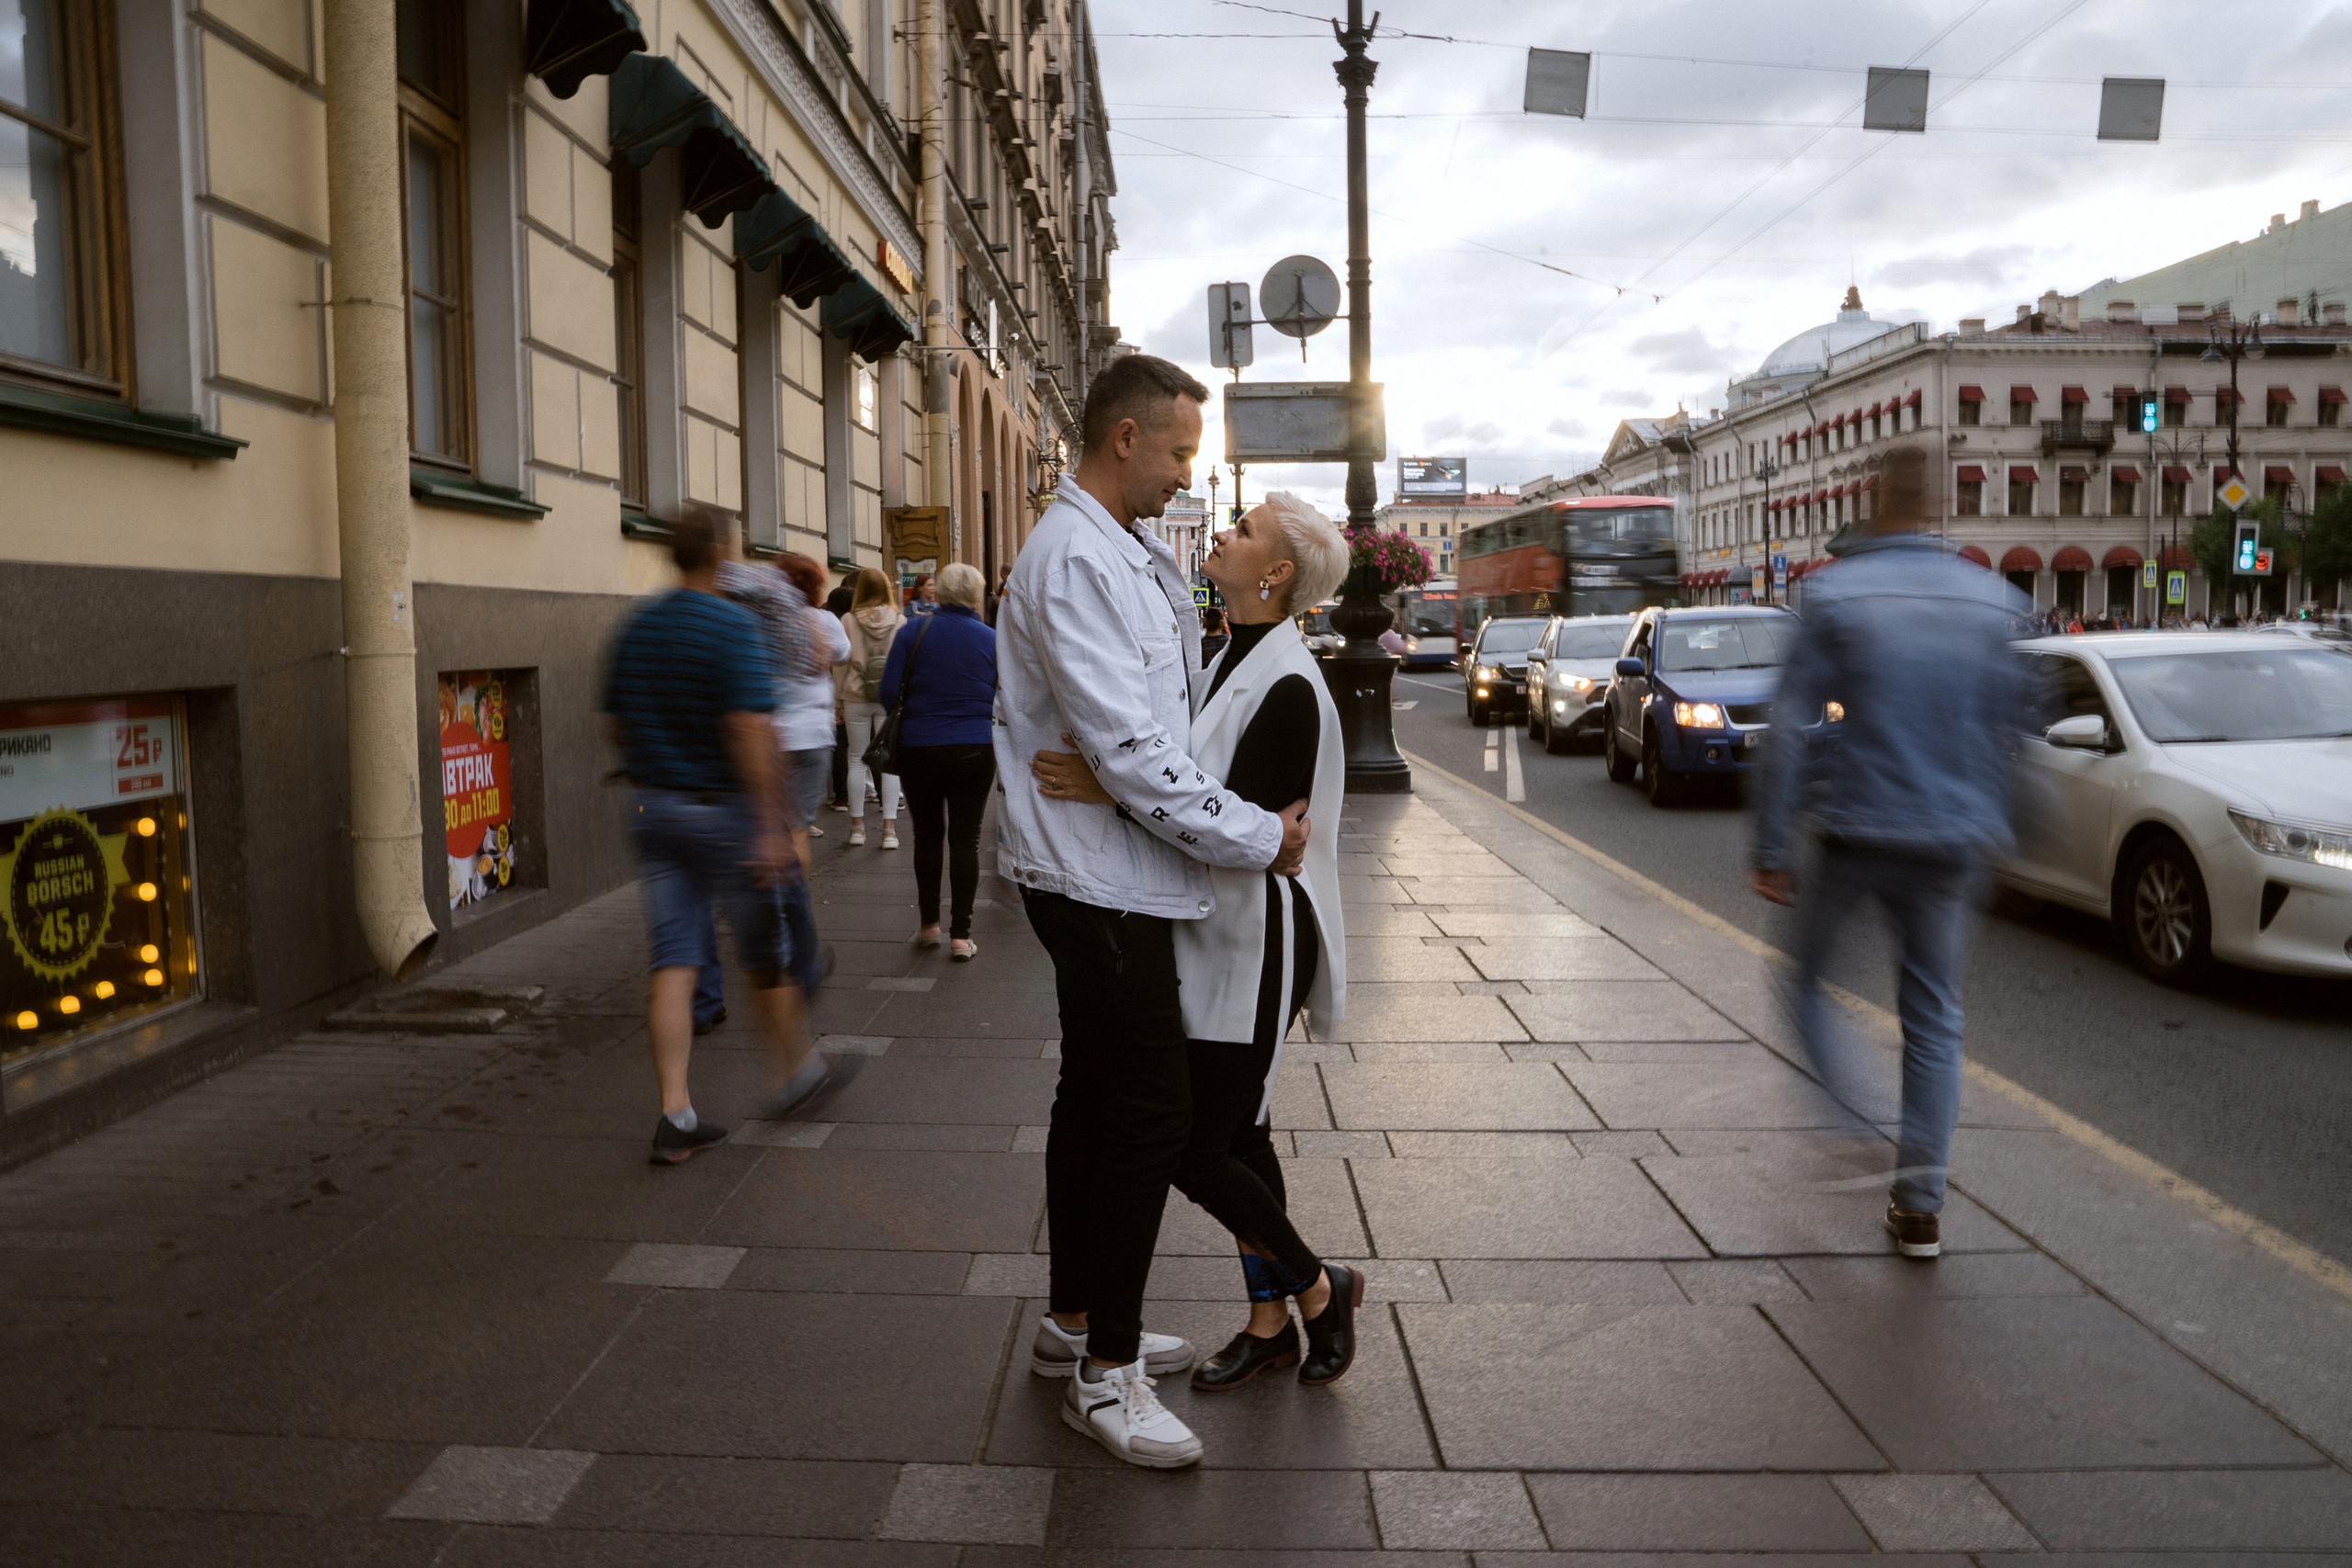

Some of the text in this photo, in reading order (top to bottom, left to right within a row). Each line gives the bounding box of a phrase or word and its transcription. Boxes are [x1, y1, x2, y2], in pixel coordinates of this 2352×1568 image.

[442, 752, 494, 796] ВТРАК
[471, 787, 500, 820] 11:00
[34, 853, 85, 879] RUSSIAN
[27, 869, 95, 908] BORSCH
